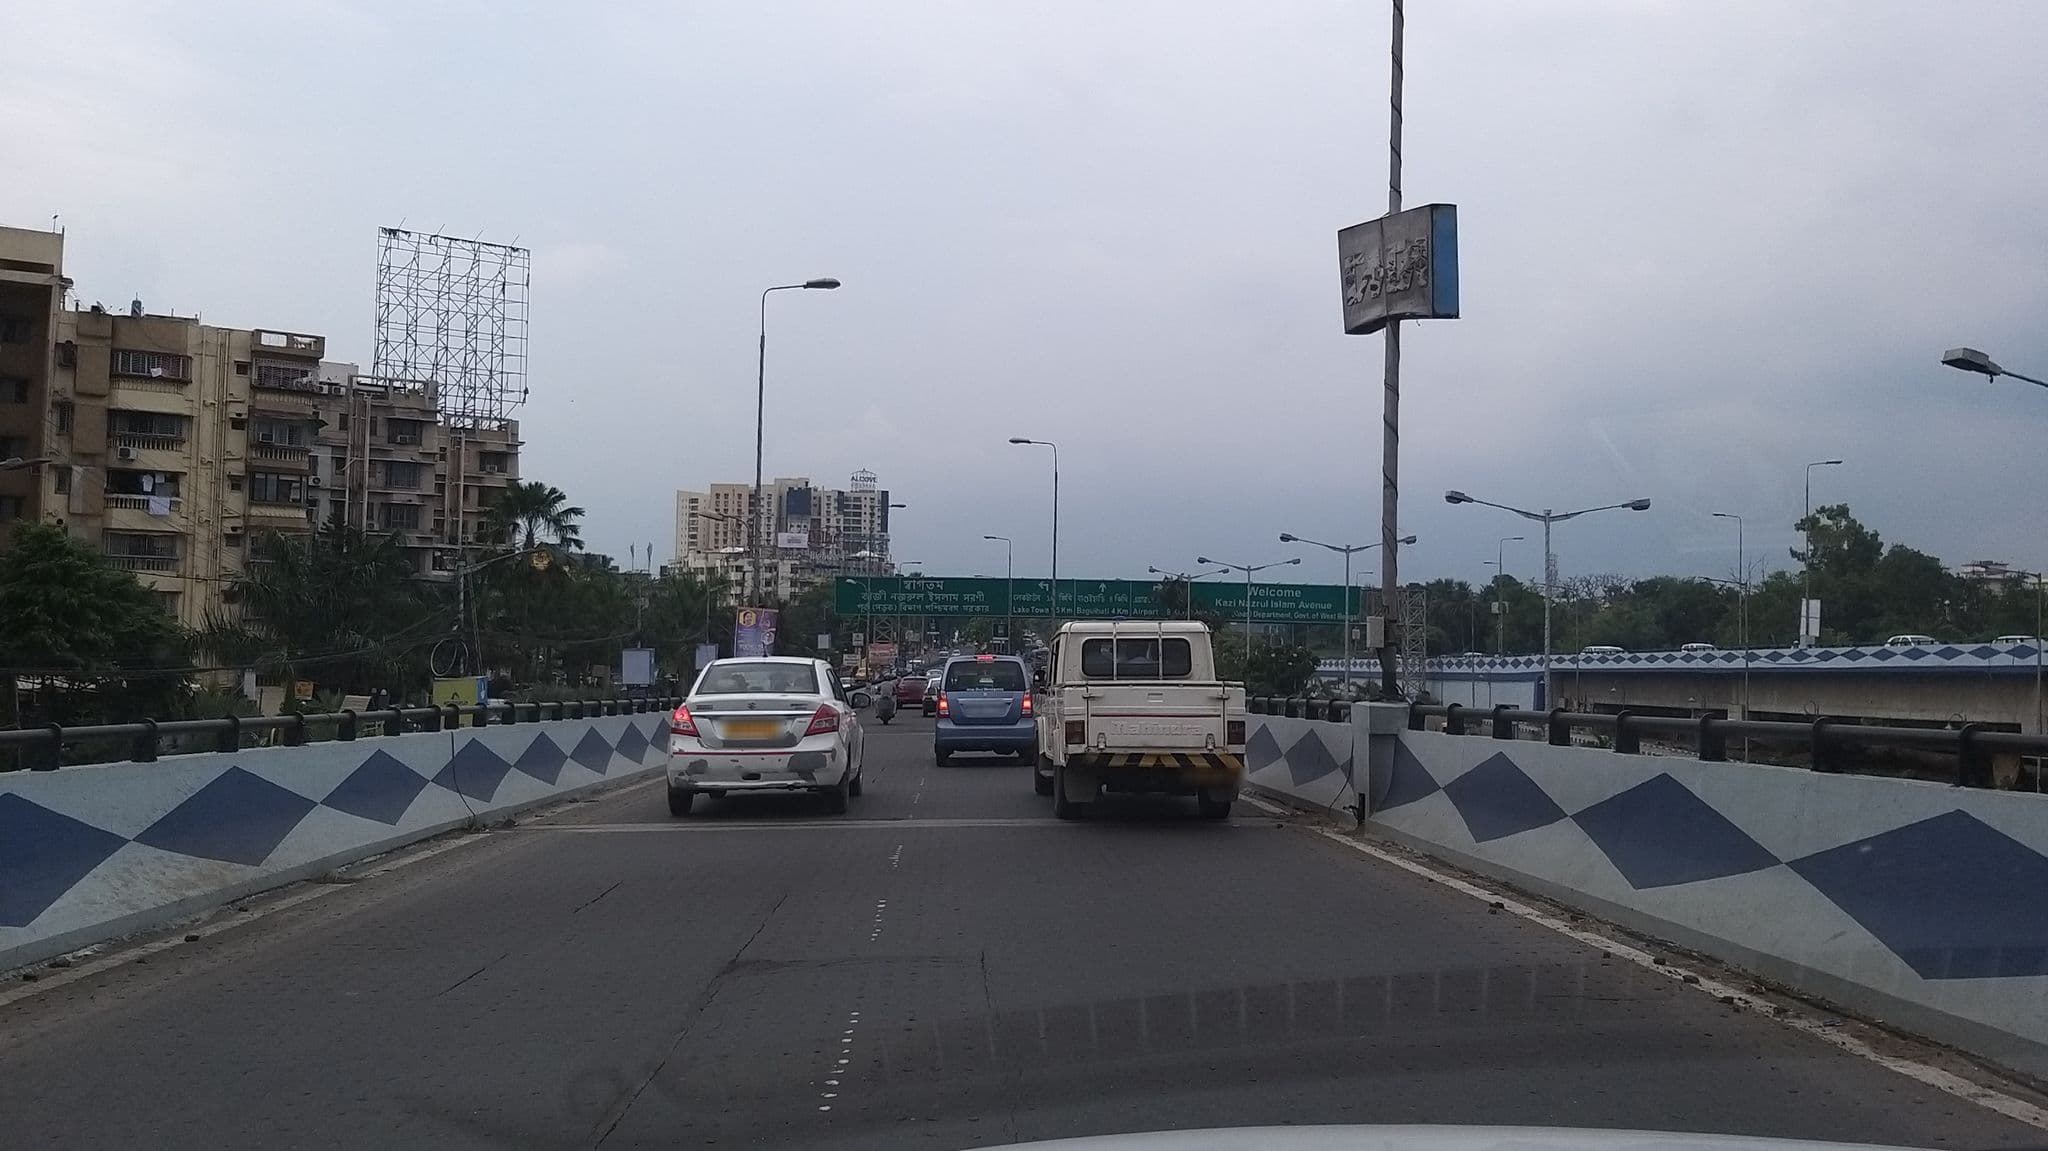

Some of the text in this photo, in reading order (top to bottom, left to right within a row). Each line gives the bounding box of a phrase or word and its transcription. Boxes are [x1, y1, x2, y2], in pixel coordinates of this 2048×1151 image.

[904, 580, 944, 590] স্বাগতম
[928, 591, 958, 601] ইসলাম
[1249, 586, 1301, 598] Welcome
[1215, 599, 1332, 610] Kazi Nazrul Islam Avenue
[1013, 606, 1030, 614] Lake
[1117, 607, 1129, 615] Km
[1133, 608, 1159, 616] Airport
[1110, 720, 1203, 736] Mahindra
